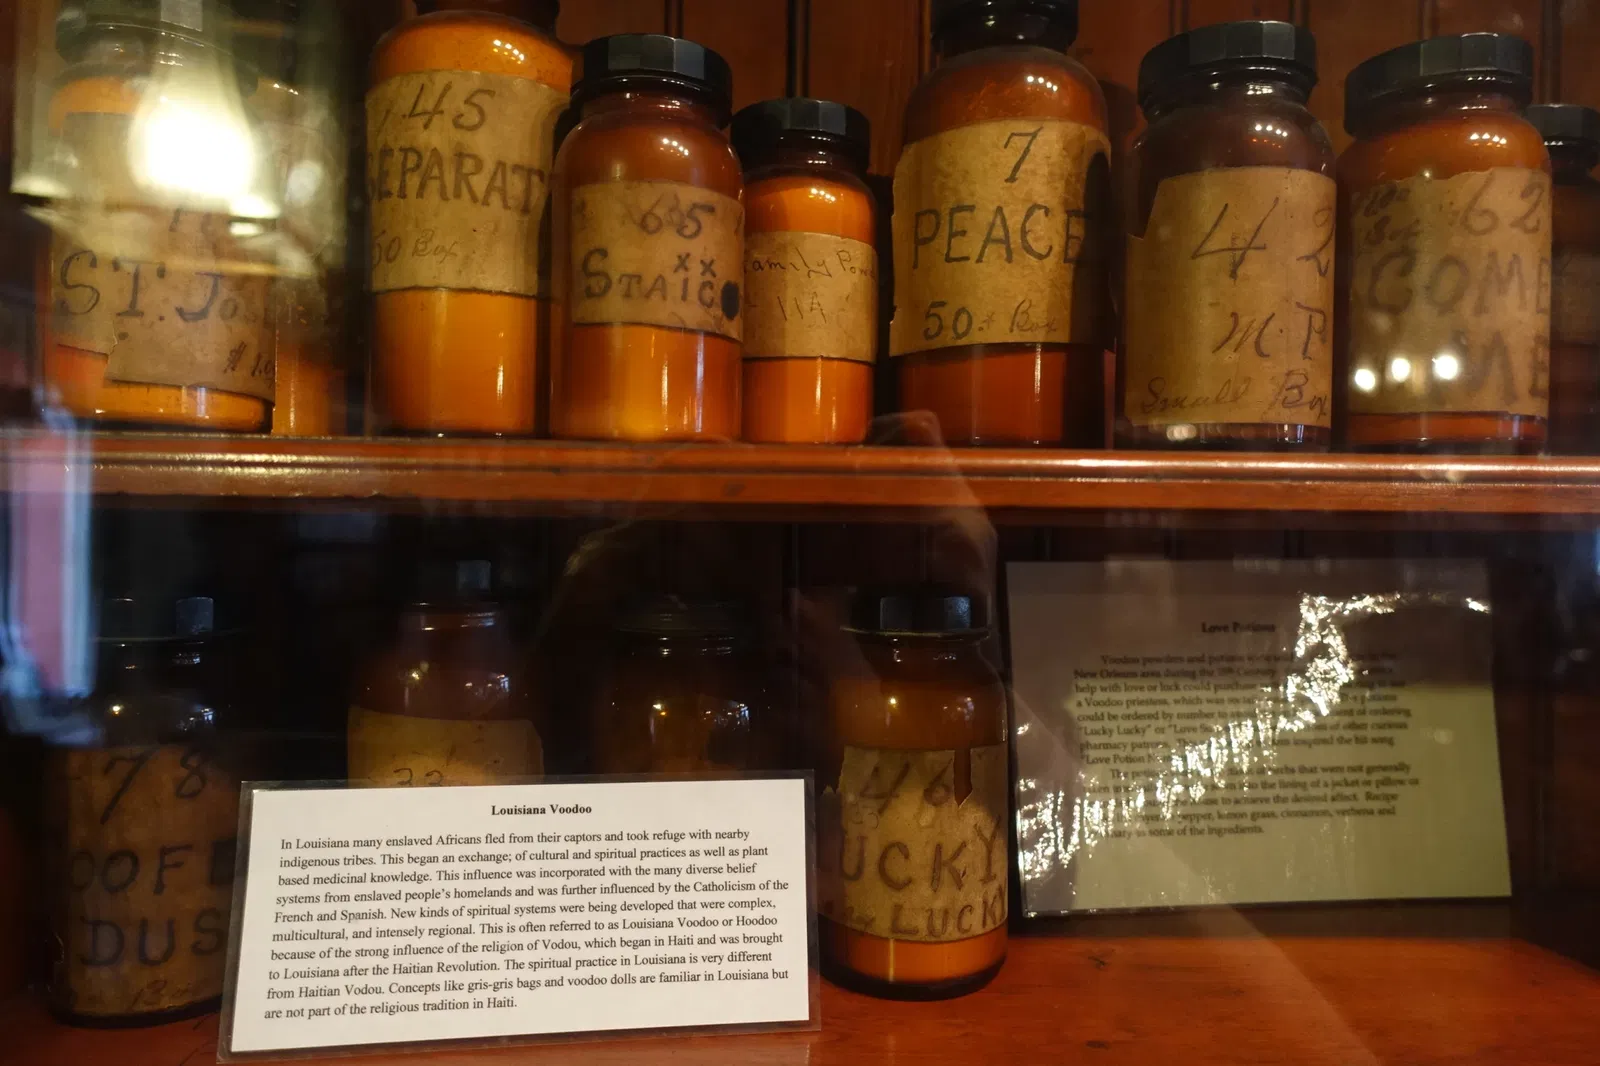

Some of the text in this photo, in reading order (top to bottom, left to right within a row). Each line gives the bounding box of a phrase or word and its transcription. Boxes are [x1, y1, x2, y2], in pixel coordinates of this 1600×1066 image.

[401, 80, 497, 132] 45
[1003, 125, 1045, 184] 7
[1459, 168, 1546, 237] 62
[491, 803, 592, 816] Louisiana Voodoo
[280, 828, 750, 850] In Louisiana many enslaved Africans fled from their captors and took refuge with nearby
[279, 845, 768, 870] indigenous tribes. This began an exchange; of cultural and spiritual practices as well as plant
[278, 862, 758, 886] based medicinal knowledge. This influence was incorporated with the many diverse belief
[275, 878, 789, 907] systems from enslaved people's homelands and was further influenced by the Catholicism of the
[272, 914, 778, 942] multicultural, and intensely regional. This is often referred to as Louisiana Voodoo or Hoodoo
[270, 931, 783, 961] because of the strong influence of the religion of Vodou, which began in Haiti and was brought
[266, 968, 789, 999] from Haitian Vodou. Concepts like gris-gris bags and voodoo dolls are familiar in Louisiana but
[263, 996, 517, 1020] are not part of the religious tradition in Haiti.
